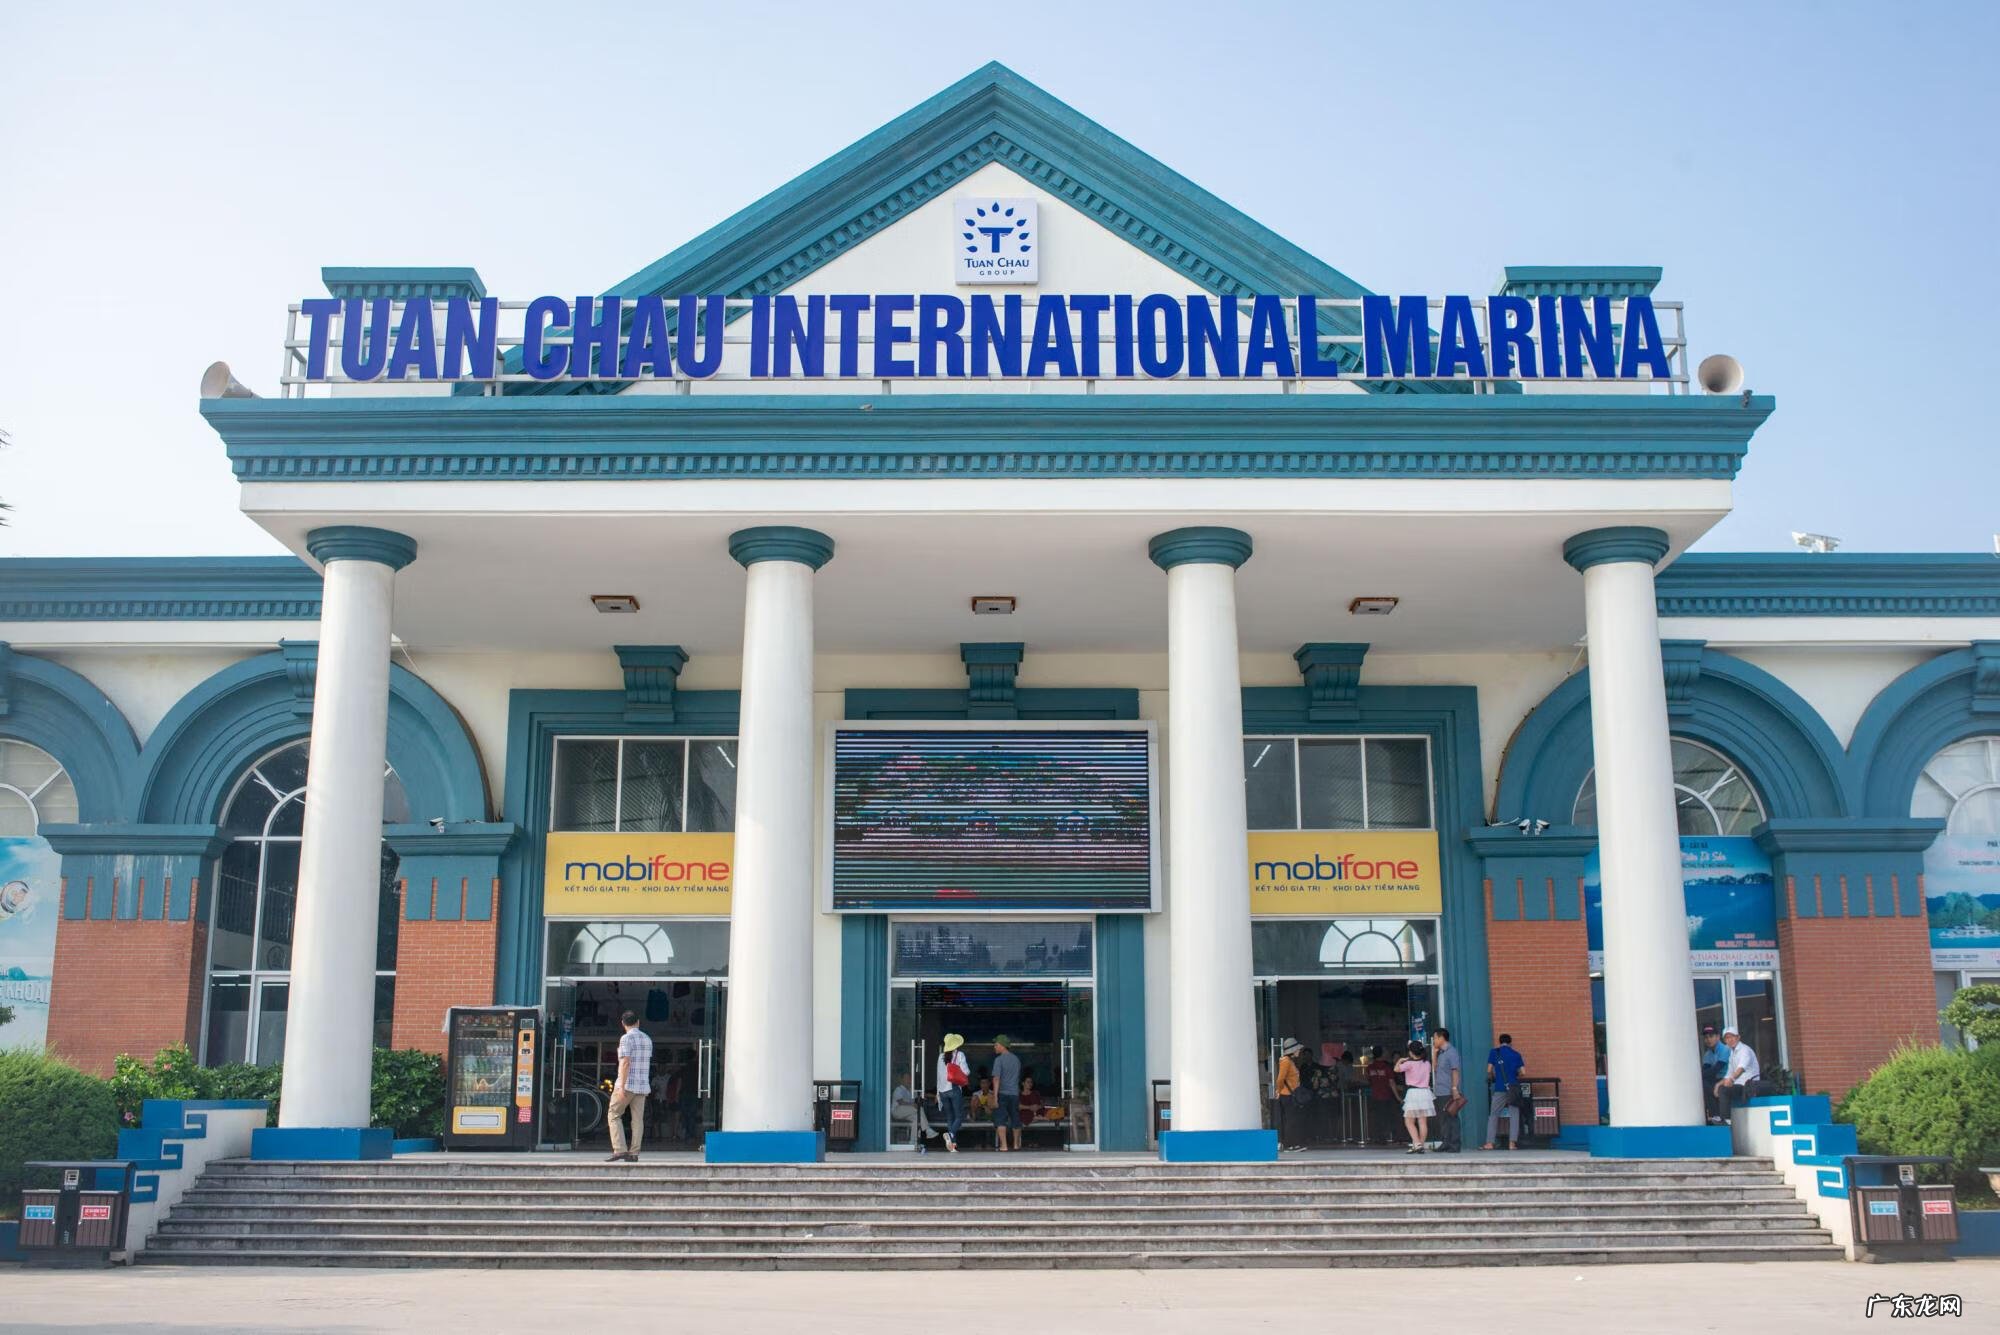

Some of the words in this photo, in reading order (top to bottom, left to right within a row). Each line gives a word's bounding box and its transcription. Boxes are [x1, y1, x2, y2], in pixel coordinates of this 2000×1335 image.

[301, 296, 498, 381] TUAN
[524, 295, 725, 381] CHAU
[749, 294, 1338, 379] INTERNATIONAL
[1362, 295, 1671, 379] MARINA
[565, 854, 730, 881] mobifone
[1255, 853, 1419, 880] mobifone
